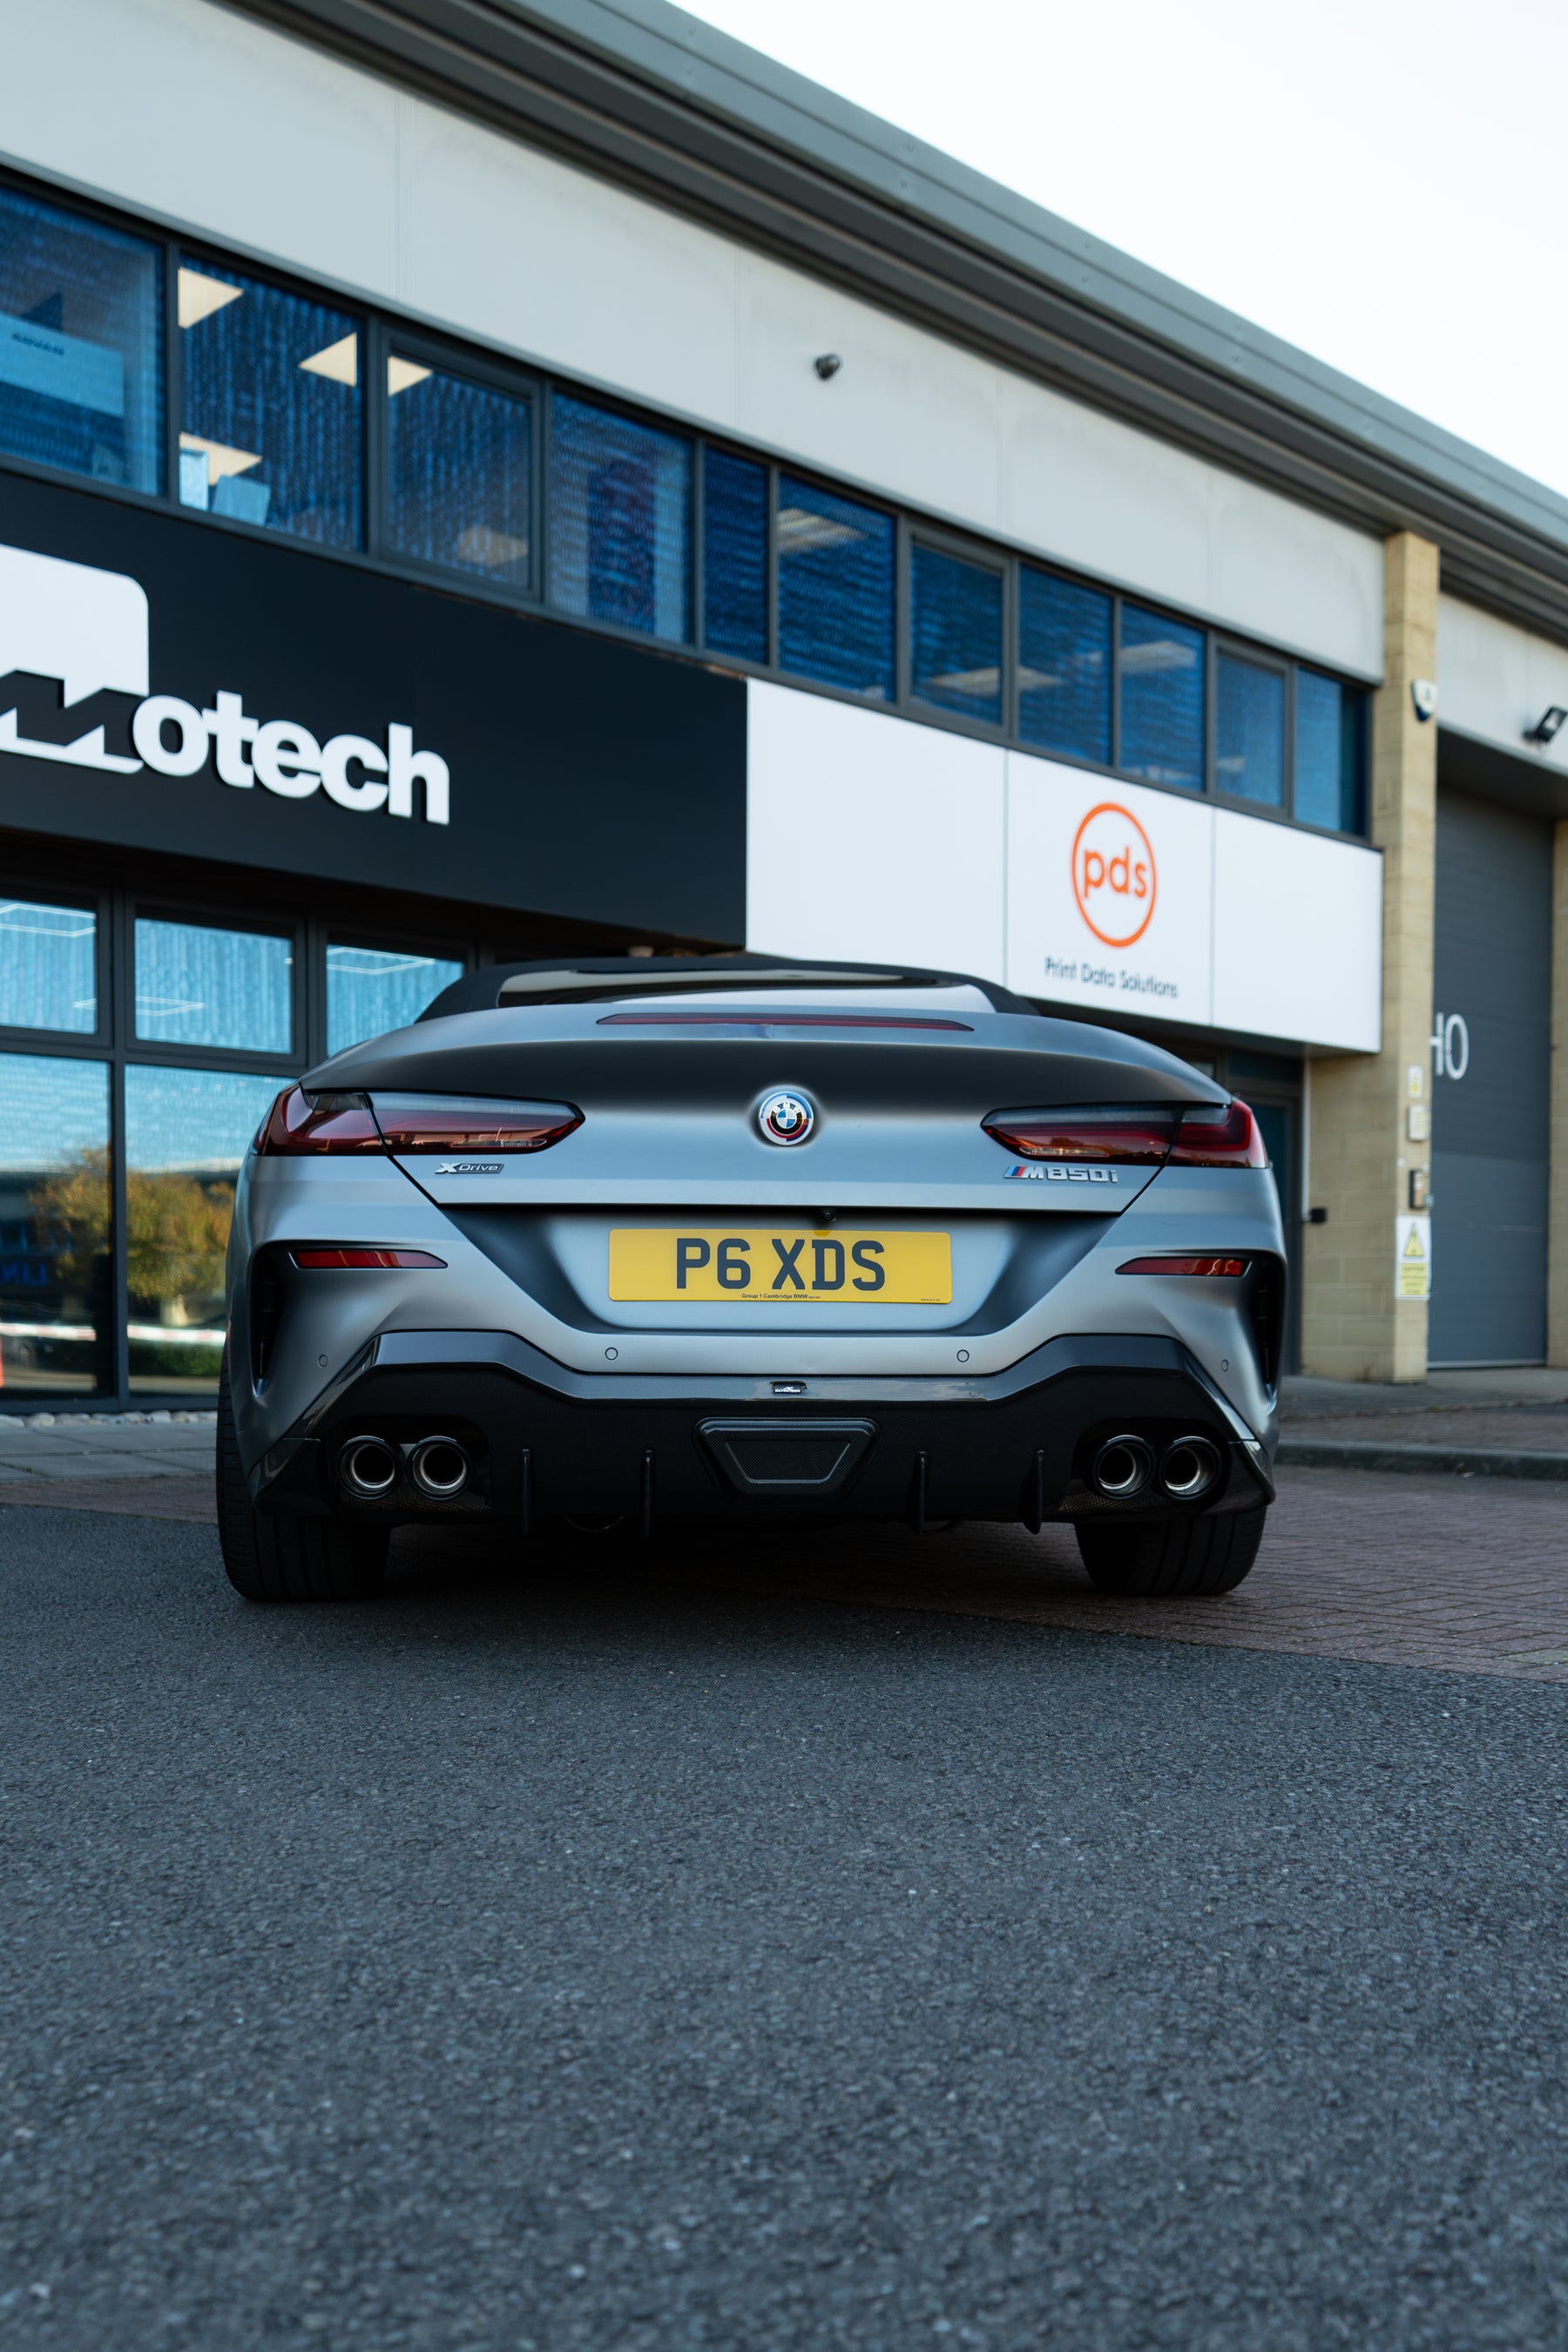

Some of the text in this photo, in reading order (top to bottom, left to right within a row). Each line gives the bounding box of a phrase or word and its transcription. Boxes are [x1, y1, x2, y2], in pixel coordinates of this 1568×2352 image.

[1084, 845, 1147, 898] pds
[1044, 956, 1179, 999] Print Data Solutions
[772, 1102, 801, 1114] BMW
[1022, 1166, 1119, 1183] M850i
[676, 1237, 885, 1291] P6 XDS
